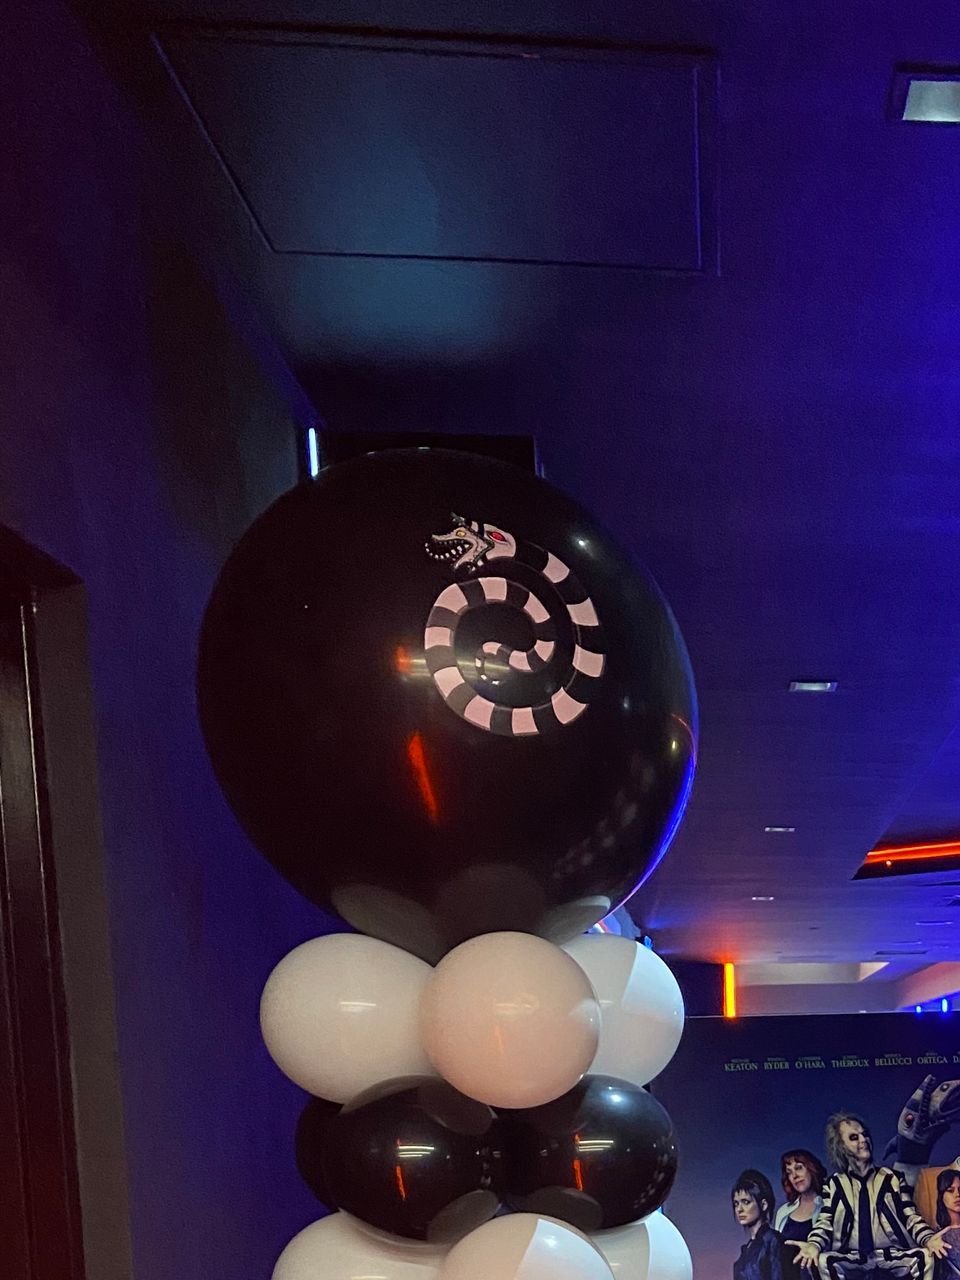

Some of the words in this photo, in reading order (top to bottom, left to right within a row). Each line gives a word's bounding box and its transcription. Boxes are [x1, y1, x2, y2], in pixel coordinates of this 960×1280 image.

[724, 1062, 758, 1071] KEATON
[763, 1061, 790, 1070] RYDER
[795, 1059, 826, 1069] O'HARA
[831, 1059, 869, 1068] THEROUX
[875, 1057, 912, 1066] BELLUCCI
[917, 1055, 948, 1065] ORTEGA
